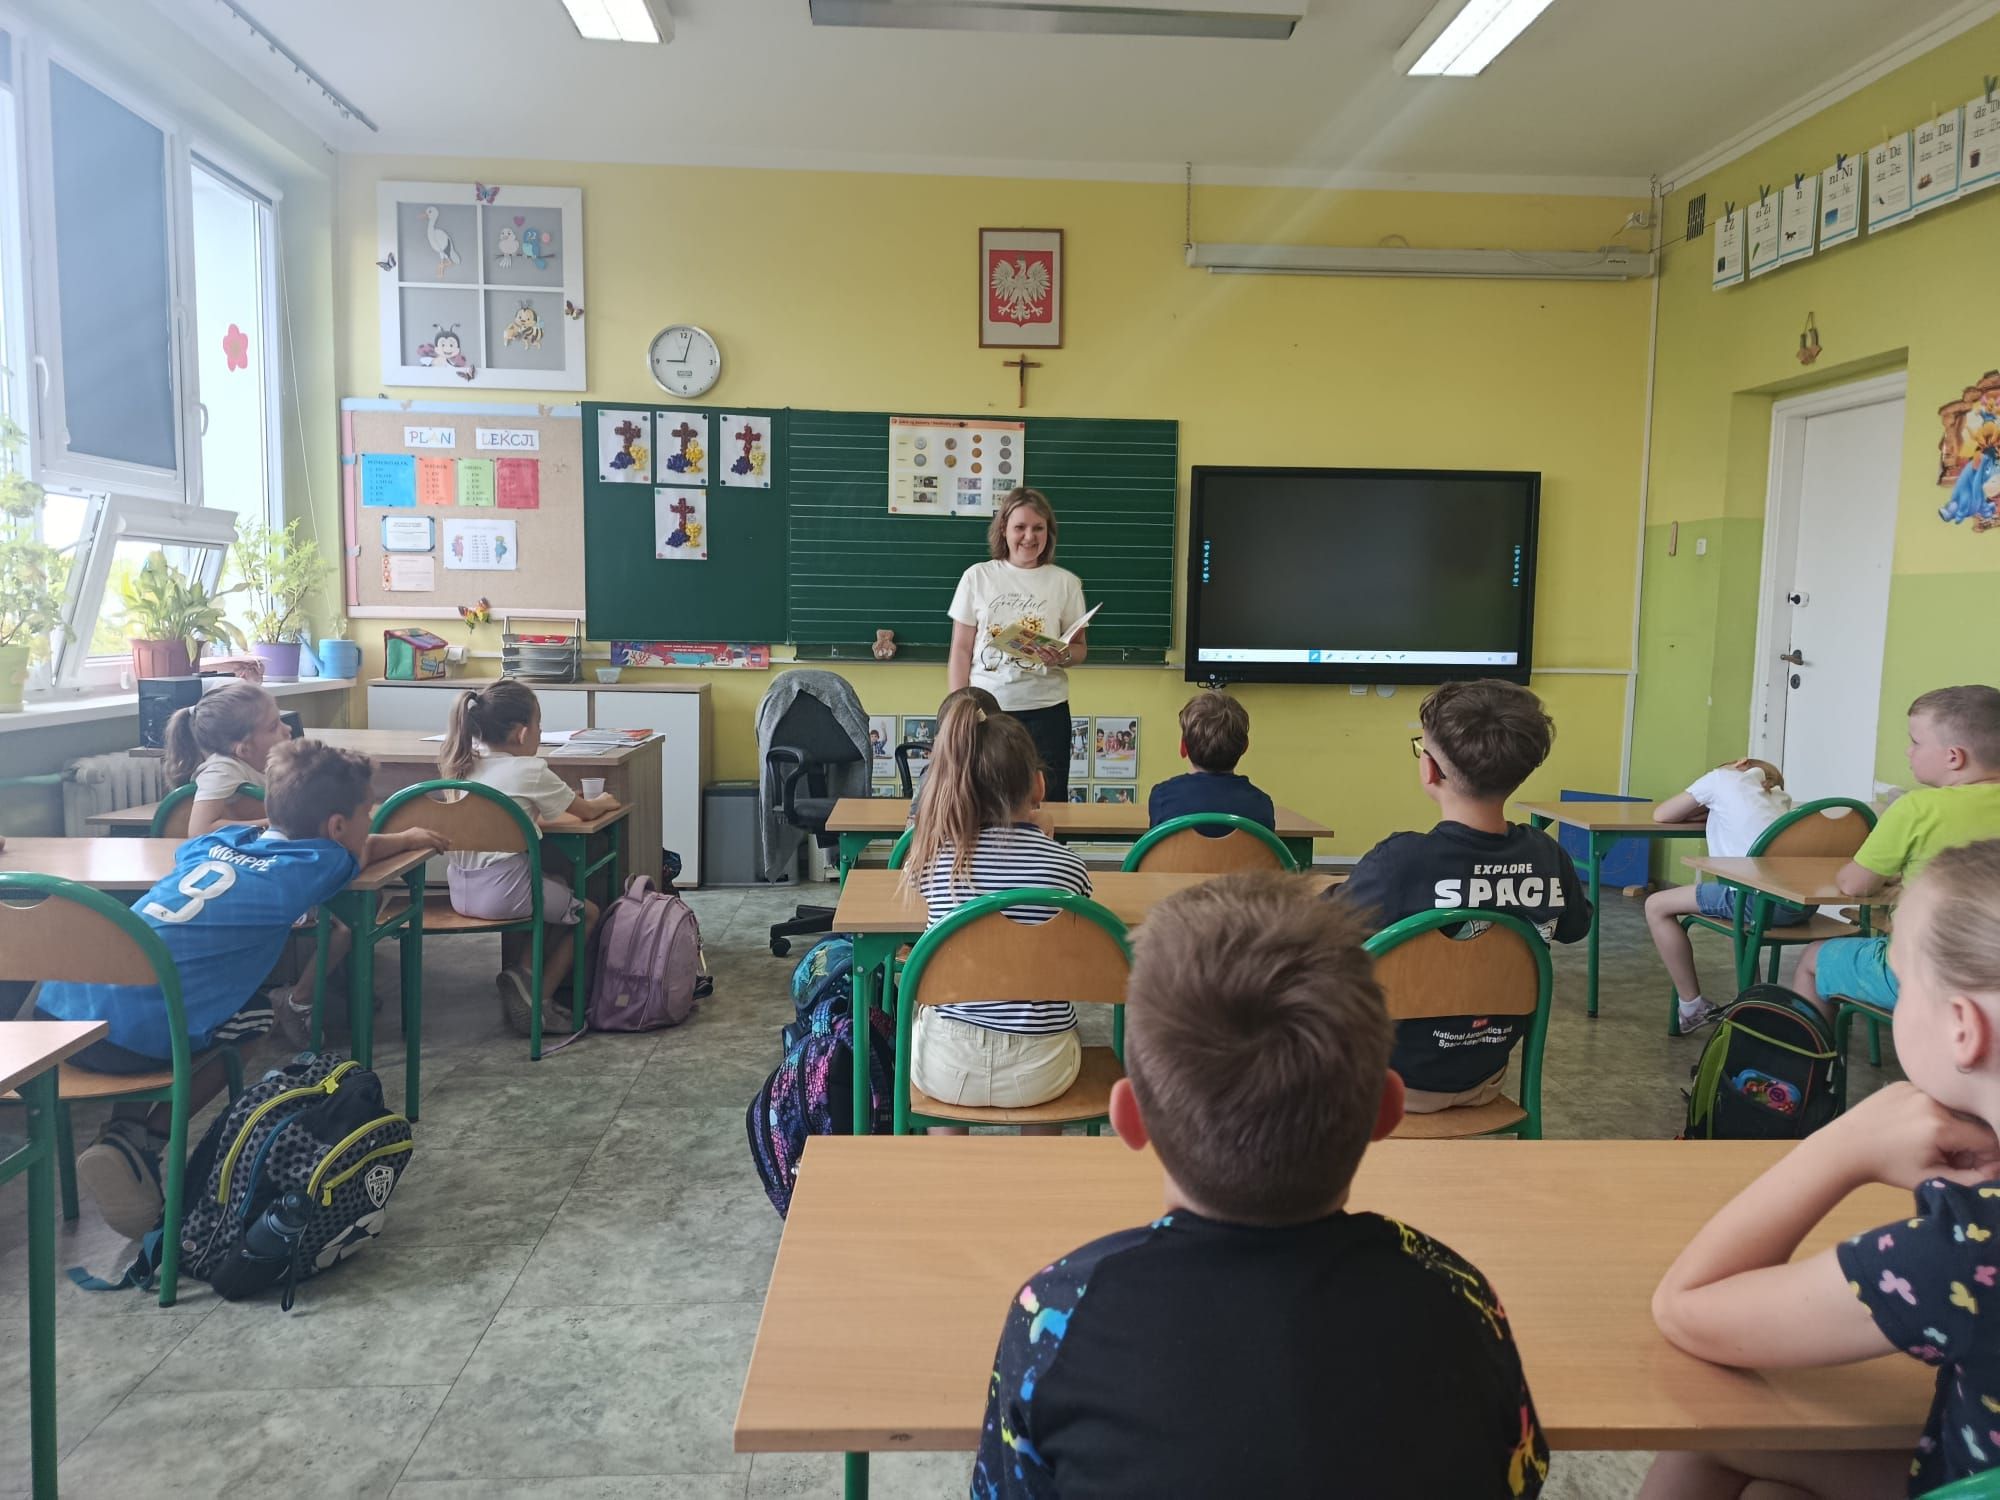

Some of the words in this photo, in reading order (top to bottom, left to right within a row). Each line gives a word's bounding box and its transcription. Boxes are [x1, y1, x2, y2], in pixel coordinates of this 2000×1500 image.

[409, 430, 451, 445] PLAN
[481, 431, 536, 447] LEKCJI
[1473, 863, 1533, 875] EXPLORE
[142, 860, 237, 923] 9
[1434, 877, 1566, 909] SPACE
[1432, 1029, 1466, 1041] National
